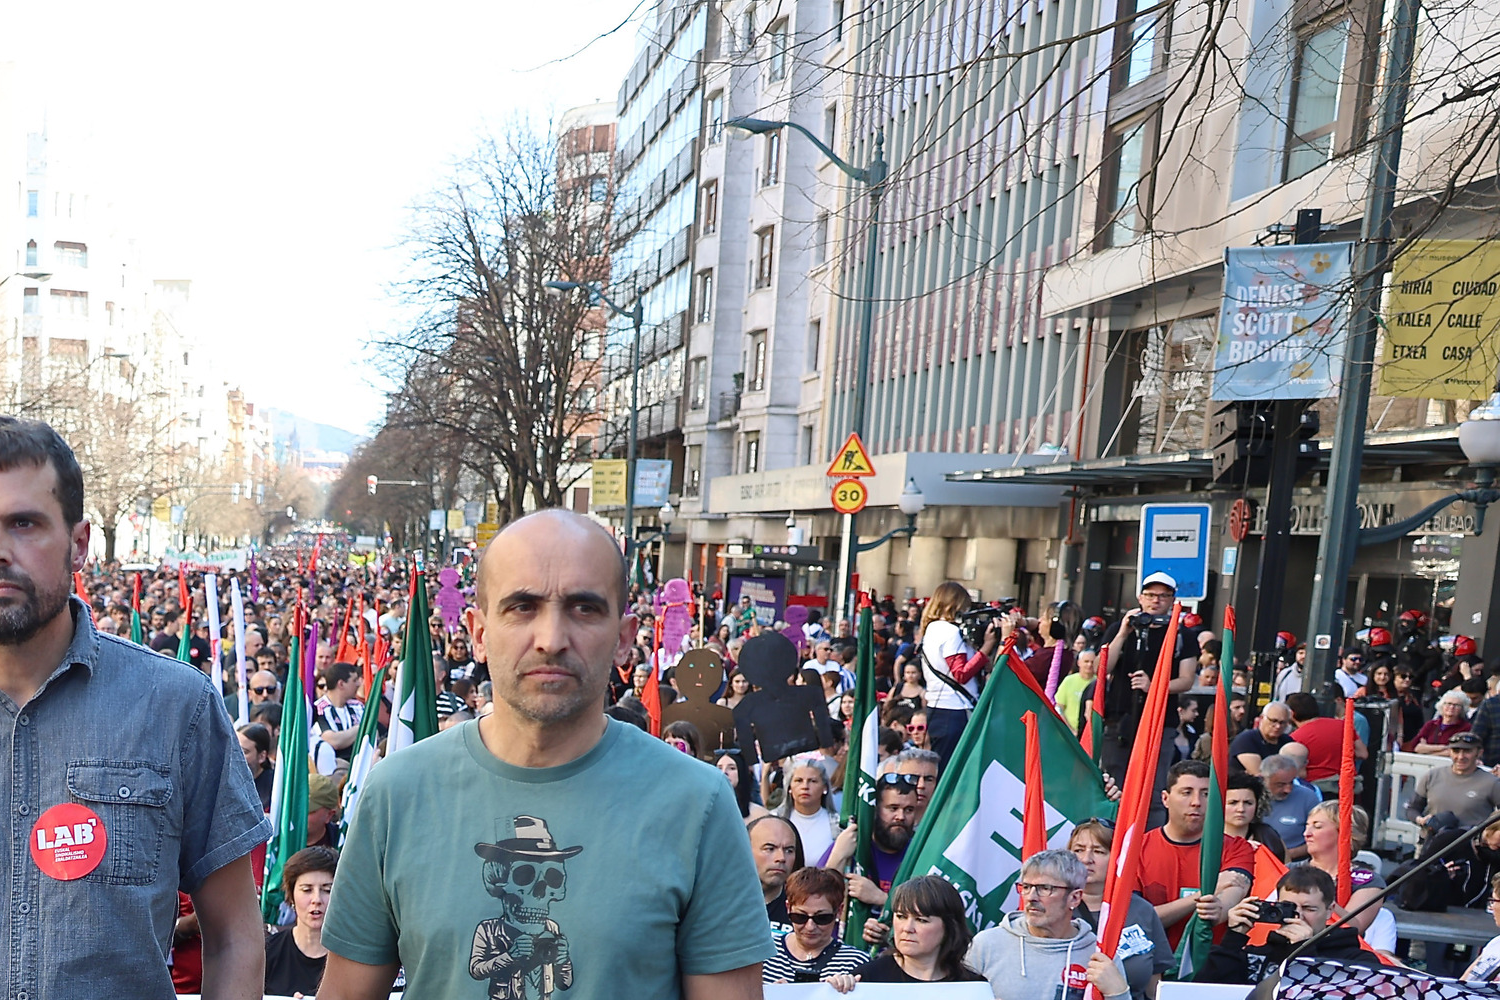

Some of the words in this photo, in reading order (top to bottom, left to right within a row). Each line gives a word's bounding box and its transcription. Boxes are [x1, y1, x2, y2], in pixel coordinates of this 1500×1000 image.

[1235, 284, 1306, 308] DENISE
[1401, 281, 1432, 295] HIRIA
[1453, 281, 1497, 296] CIUDAD
[1232, 312, 1297, 336] SCOTT
[1397, 313, 1431, 327] KALEA
[1448, 313, 1483, 328] CALLE
[1228, 340, 1303, 363] BROWN
[1393, 345, 1426, 359] ETXEA
[1443, 346, 1472, 360] CASA
[839, 490, 860, 501] 30
[1433, 515, 1475, 530] BILBAO
[37, 823, 94, 850] LAB
